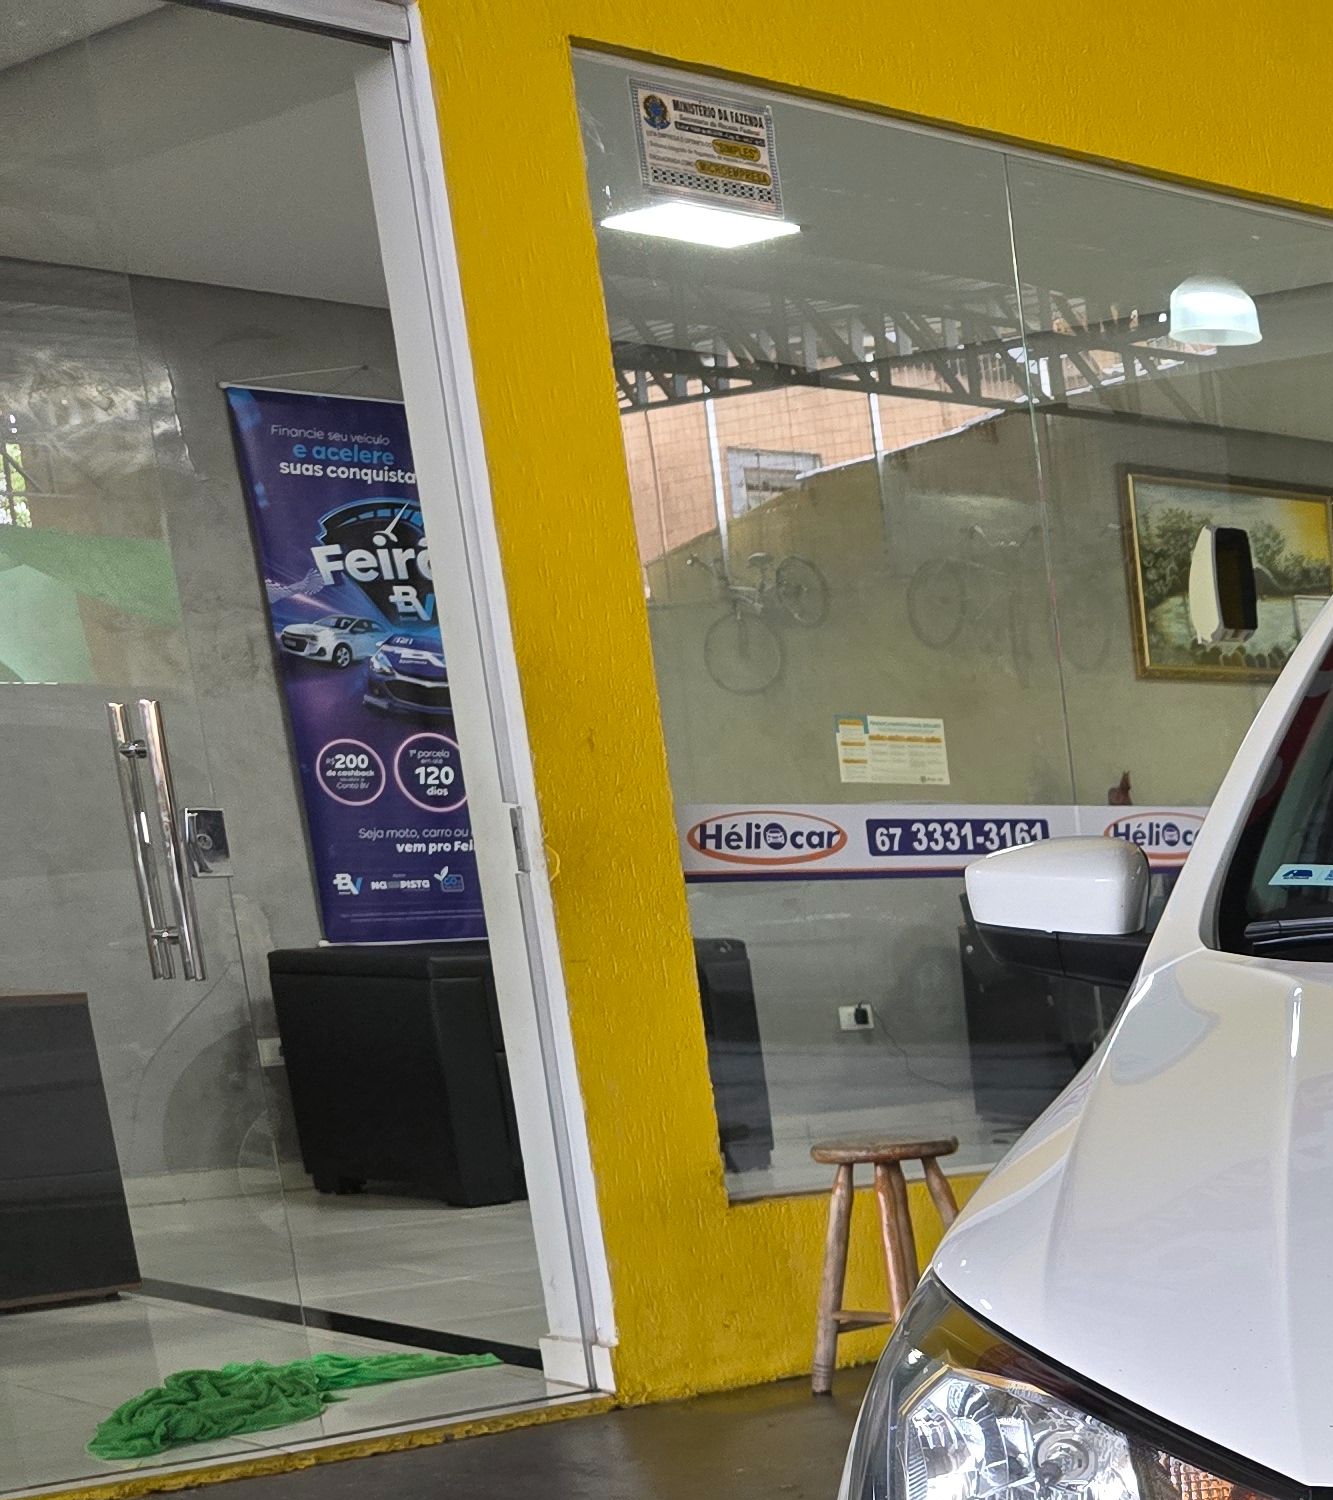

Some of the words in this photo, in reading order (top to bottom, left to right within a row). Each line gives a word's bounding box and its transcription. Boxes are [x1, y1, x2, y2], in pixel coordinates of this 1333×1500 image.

[672, 99, 716, 119] MINISTÉRIO
[718, 105, 729, 122] DA
[730, 111, 766, 130] FAZENDA
[270, 424, 325, 440] Financie
[327, 431, 348, 442] seu
[350, 432, 391, 446] veículo
[292, 443, 307, 459] e
[311, 444, 395, 465] acelere
[279, 461, 324, 477] suas
[417, 749, 450, 759] parcela
[414, 766, 455, 785] 120
[426, 786, 449, 796] dias
[358, 827, 384, 842] Seja
[422, 828, 452, 838] carro
[453, 828, 469, 838] ou
[875, 827, 902, 851] 67
[911, 822, 1043, 851] 3331-3161
[395, 841, 426, 853] vem
[428, 841, 451, 855] pro
